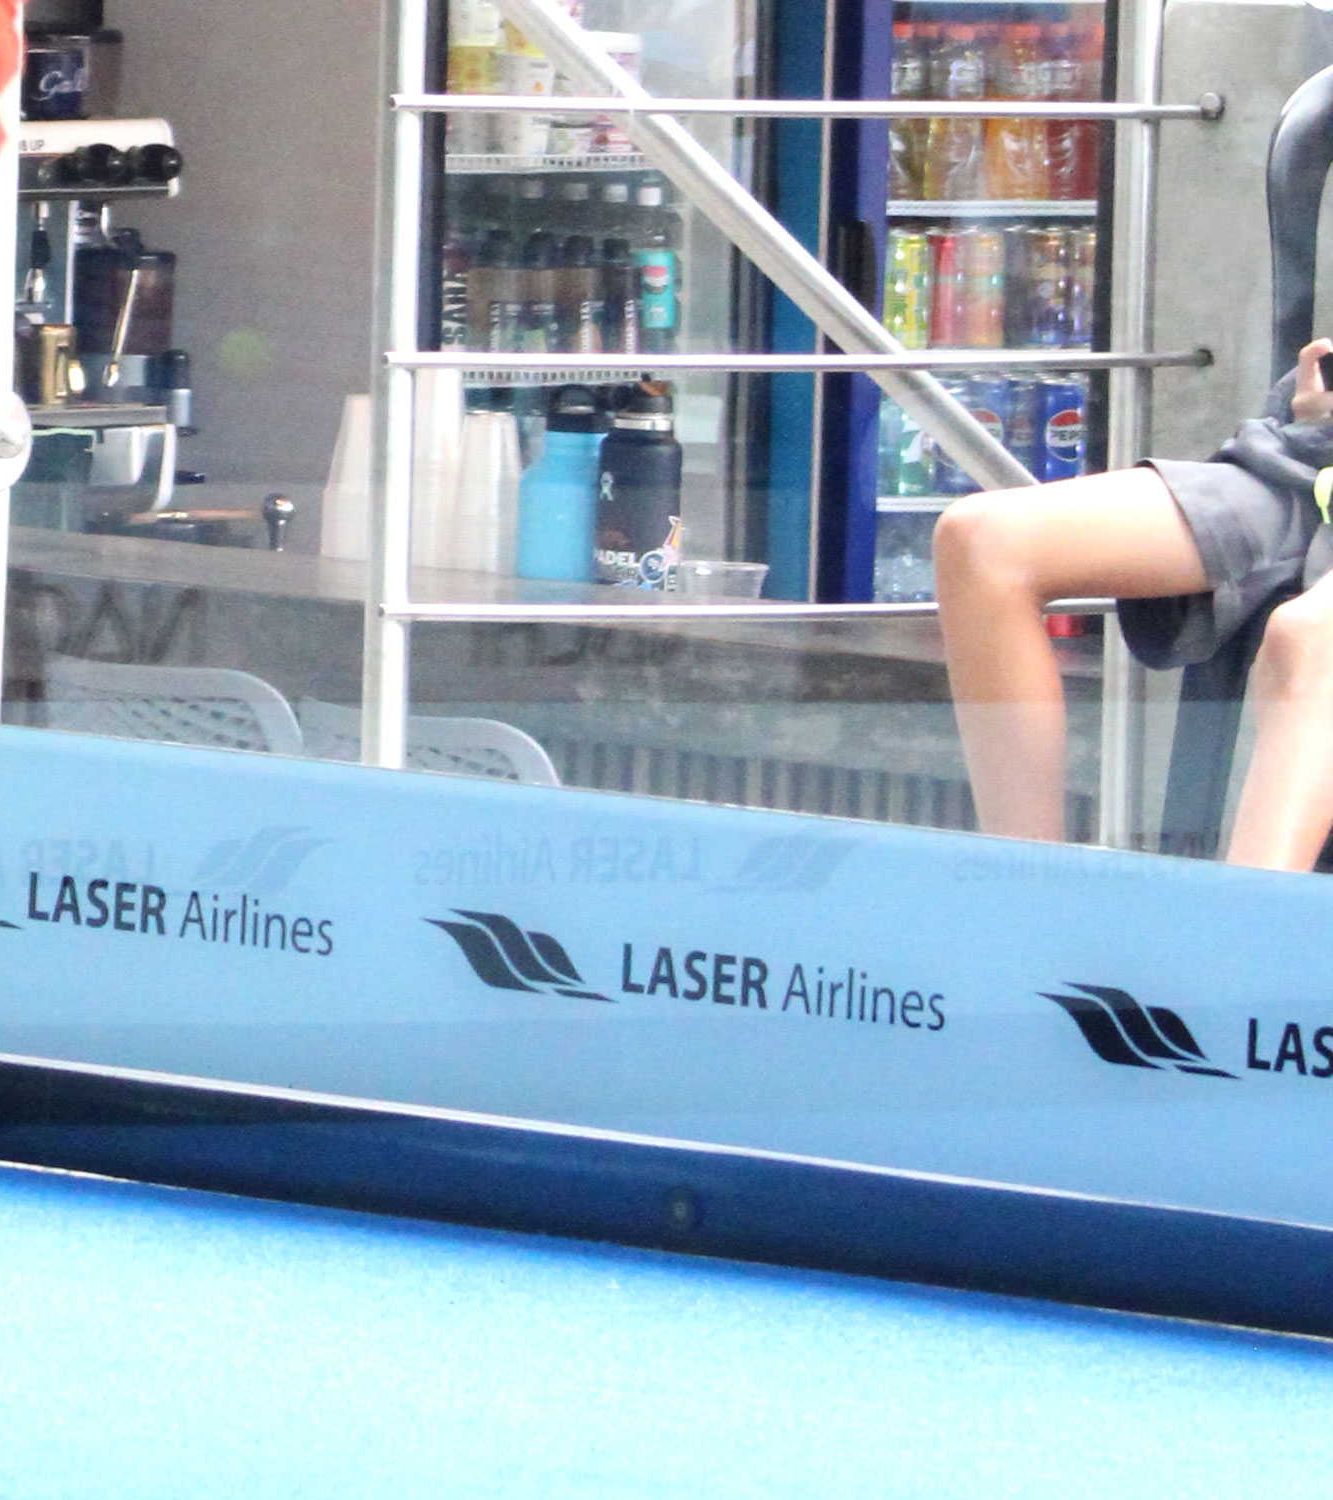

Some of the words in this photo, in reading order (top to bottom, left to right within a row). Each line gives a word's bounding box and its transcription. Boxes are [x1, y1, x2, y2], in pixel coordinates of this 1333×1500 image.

[28, 872, 167, 935] LASER
[180, 891, 334, 957] Airlines
[622, 943, 769, 1009] LASER
[782, 964, 946, 1032] Airlines
